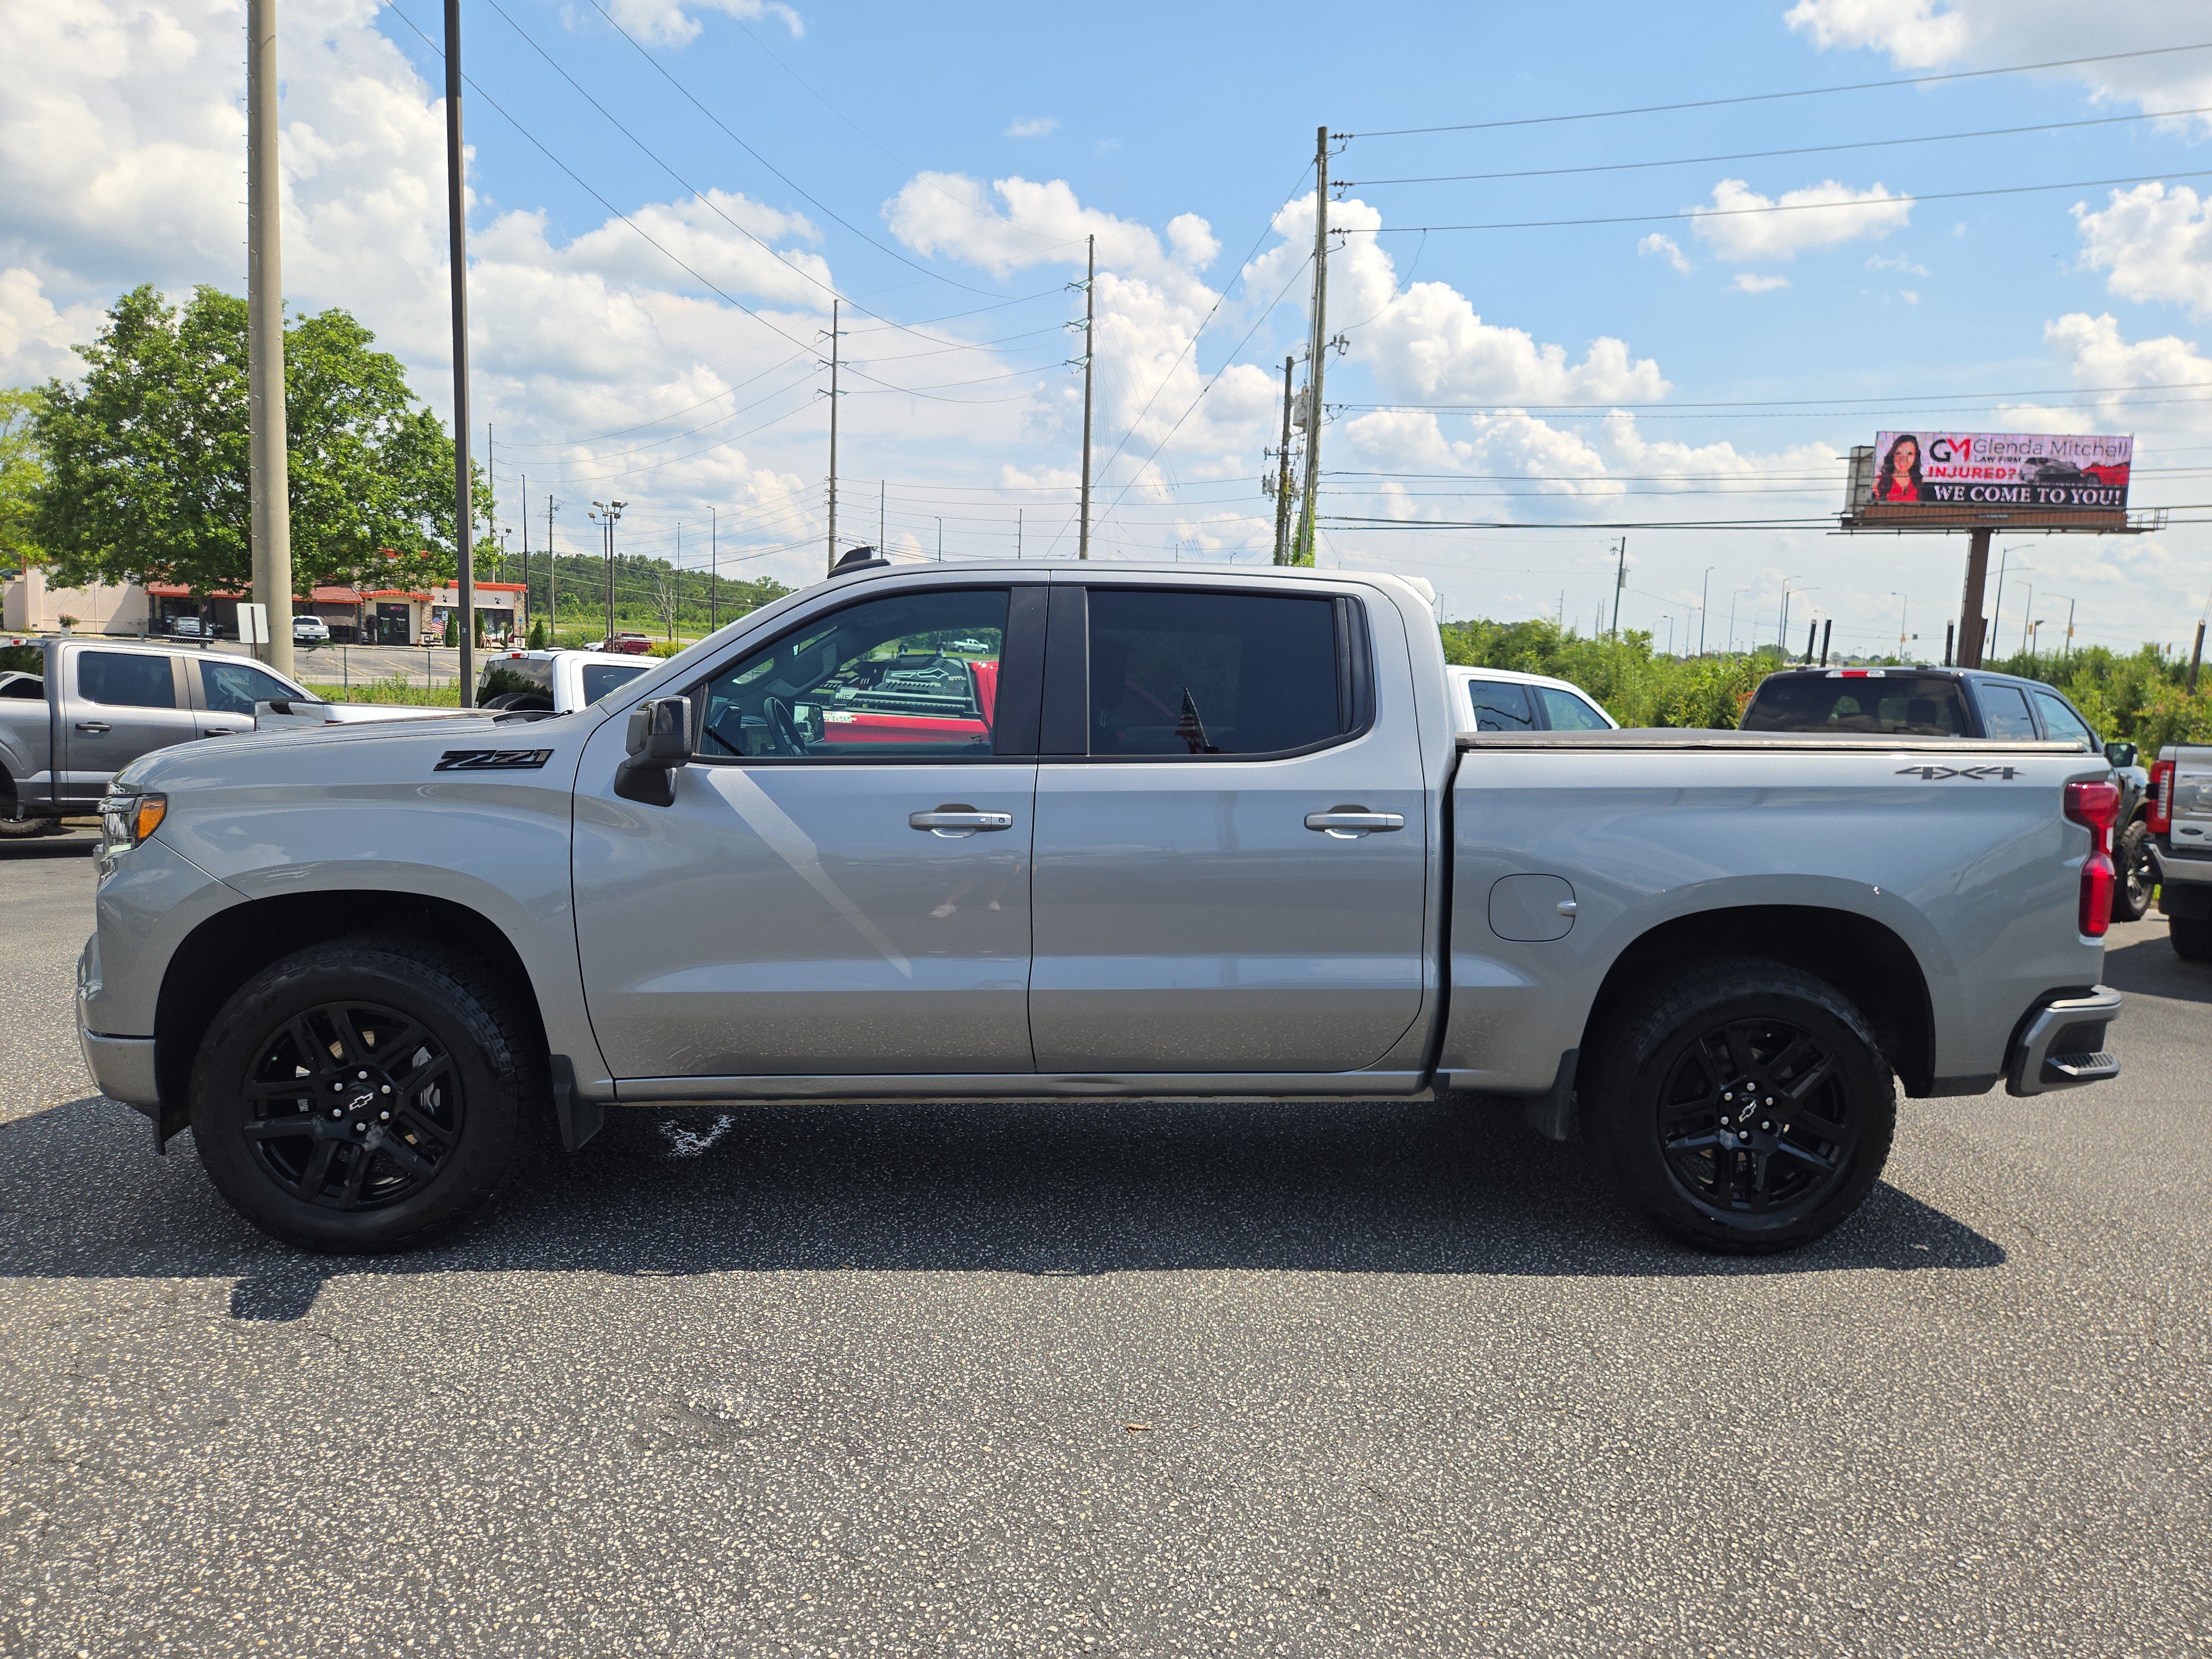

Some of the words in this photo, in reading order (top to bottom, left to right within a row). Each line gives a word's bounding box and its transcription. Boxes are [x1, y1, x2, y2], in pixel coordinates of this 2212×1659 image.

[1973, 438, 2042, 454] Glenda
[2050, 441, 2127, 457] Mitchell
[1928, 466, 2016, 479] INJURED?
[1934, 485, 1965, 501] WE
[1970, 486, 2031, 503] COME
[2037, 488, 2066, 504] TO
[2070, 488, 2121, 505] YOU!
[433, 749, 555, 771] Z71
